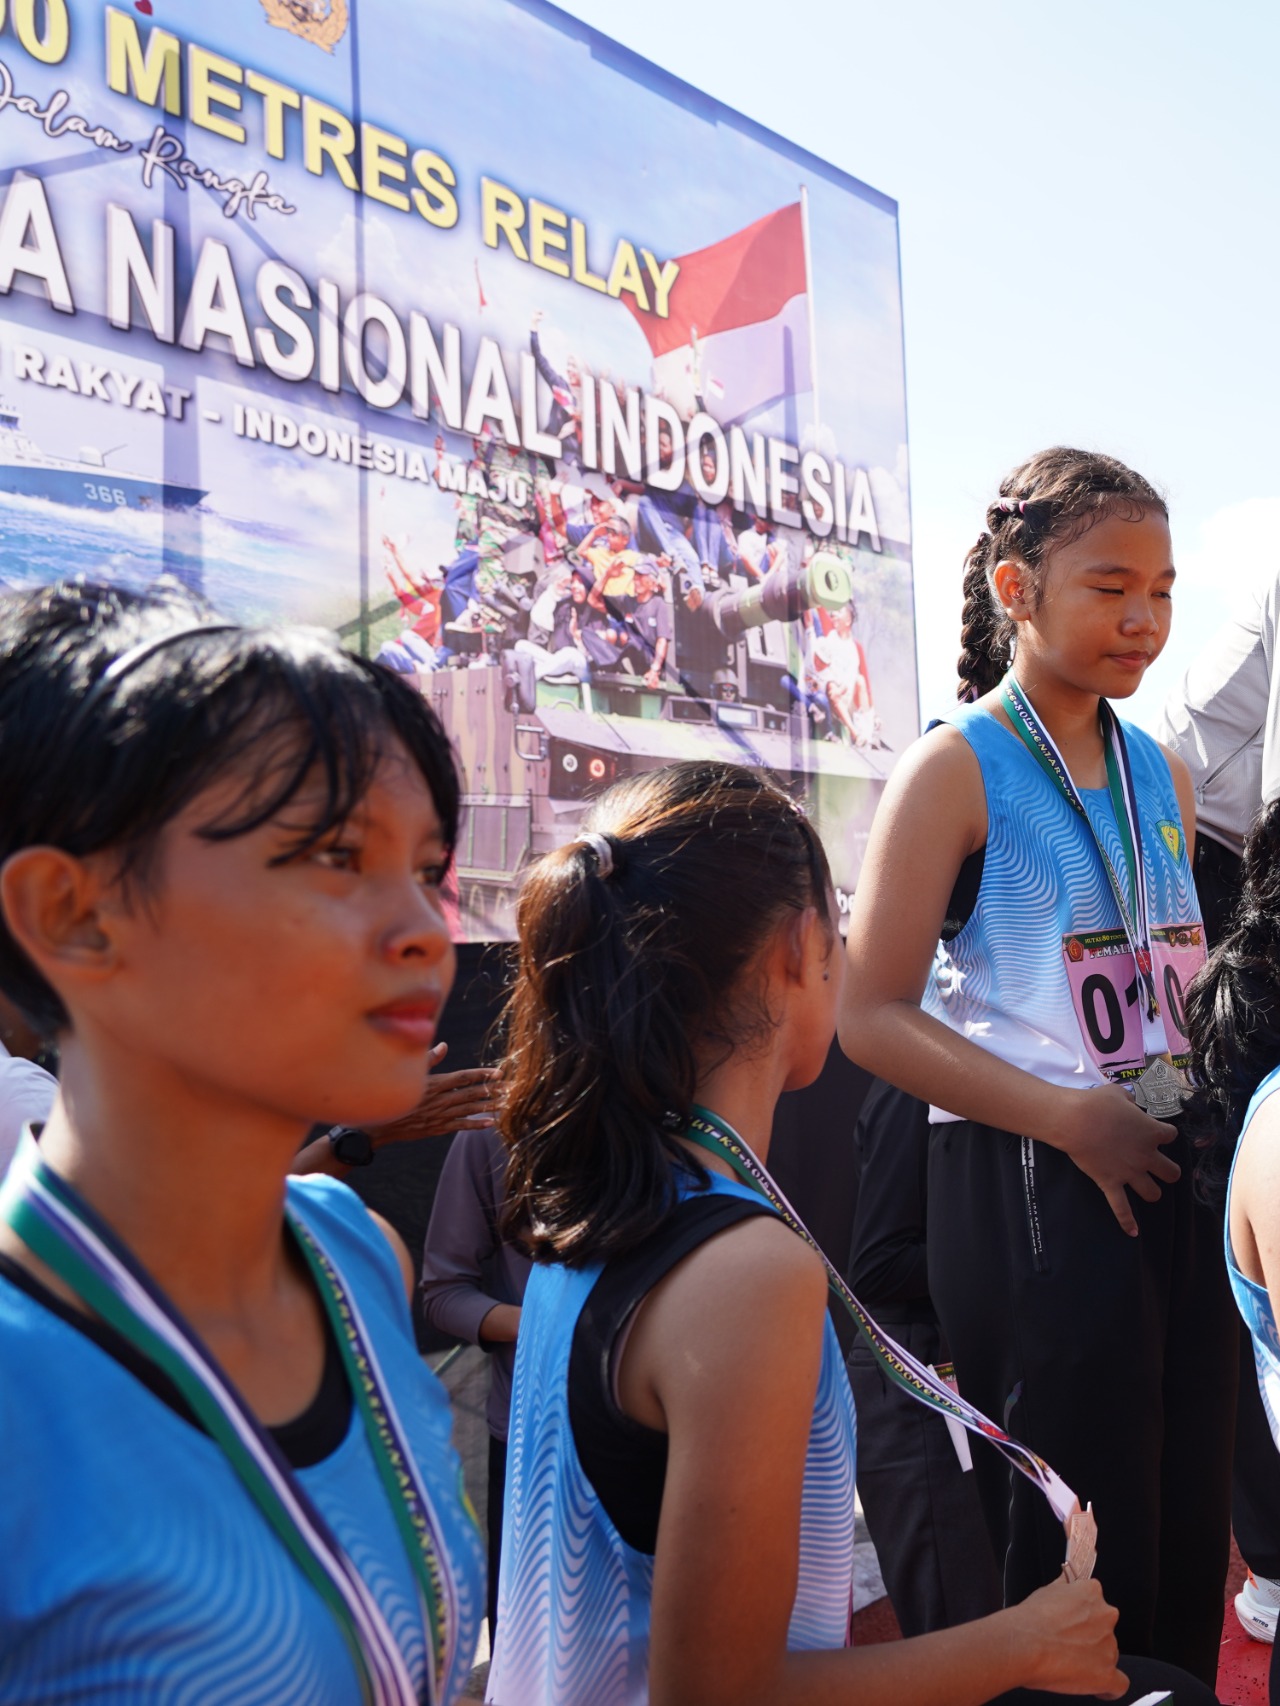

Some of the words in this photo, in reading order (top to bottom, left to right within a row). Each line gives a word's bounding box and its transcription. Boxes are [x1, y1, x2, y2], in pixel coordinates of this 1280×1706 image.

[0, 0, 70, 64] 0
[105, 6, 459, 229] METRES
[481, 176, 680, 318] RELAY
[139, 125, 296, 219] Rangka
[13, 344, 191, 421] RAKYAT
[233, 404, 429, 484] INDONESIA
[438, 459, 528, 508] MAJU
[106, 202, 562, 458] NASIONAL
[581, 373, 883, 553] INDONESIA
[83, 482, 128, 506] 366
[1121, 1068, 1138, 1079] TNI
